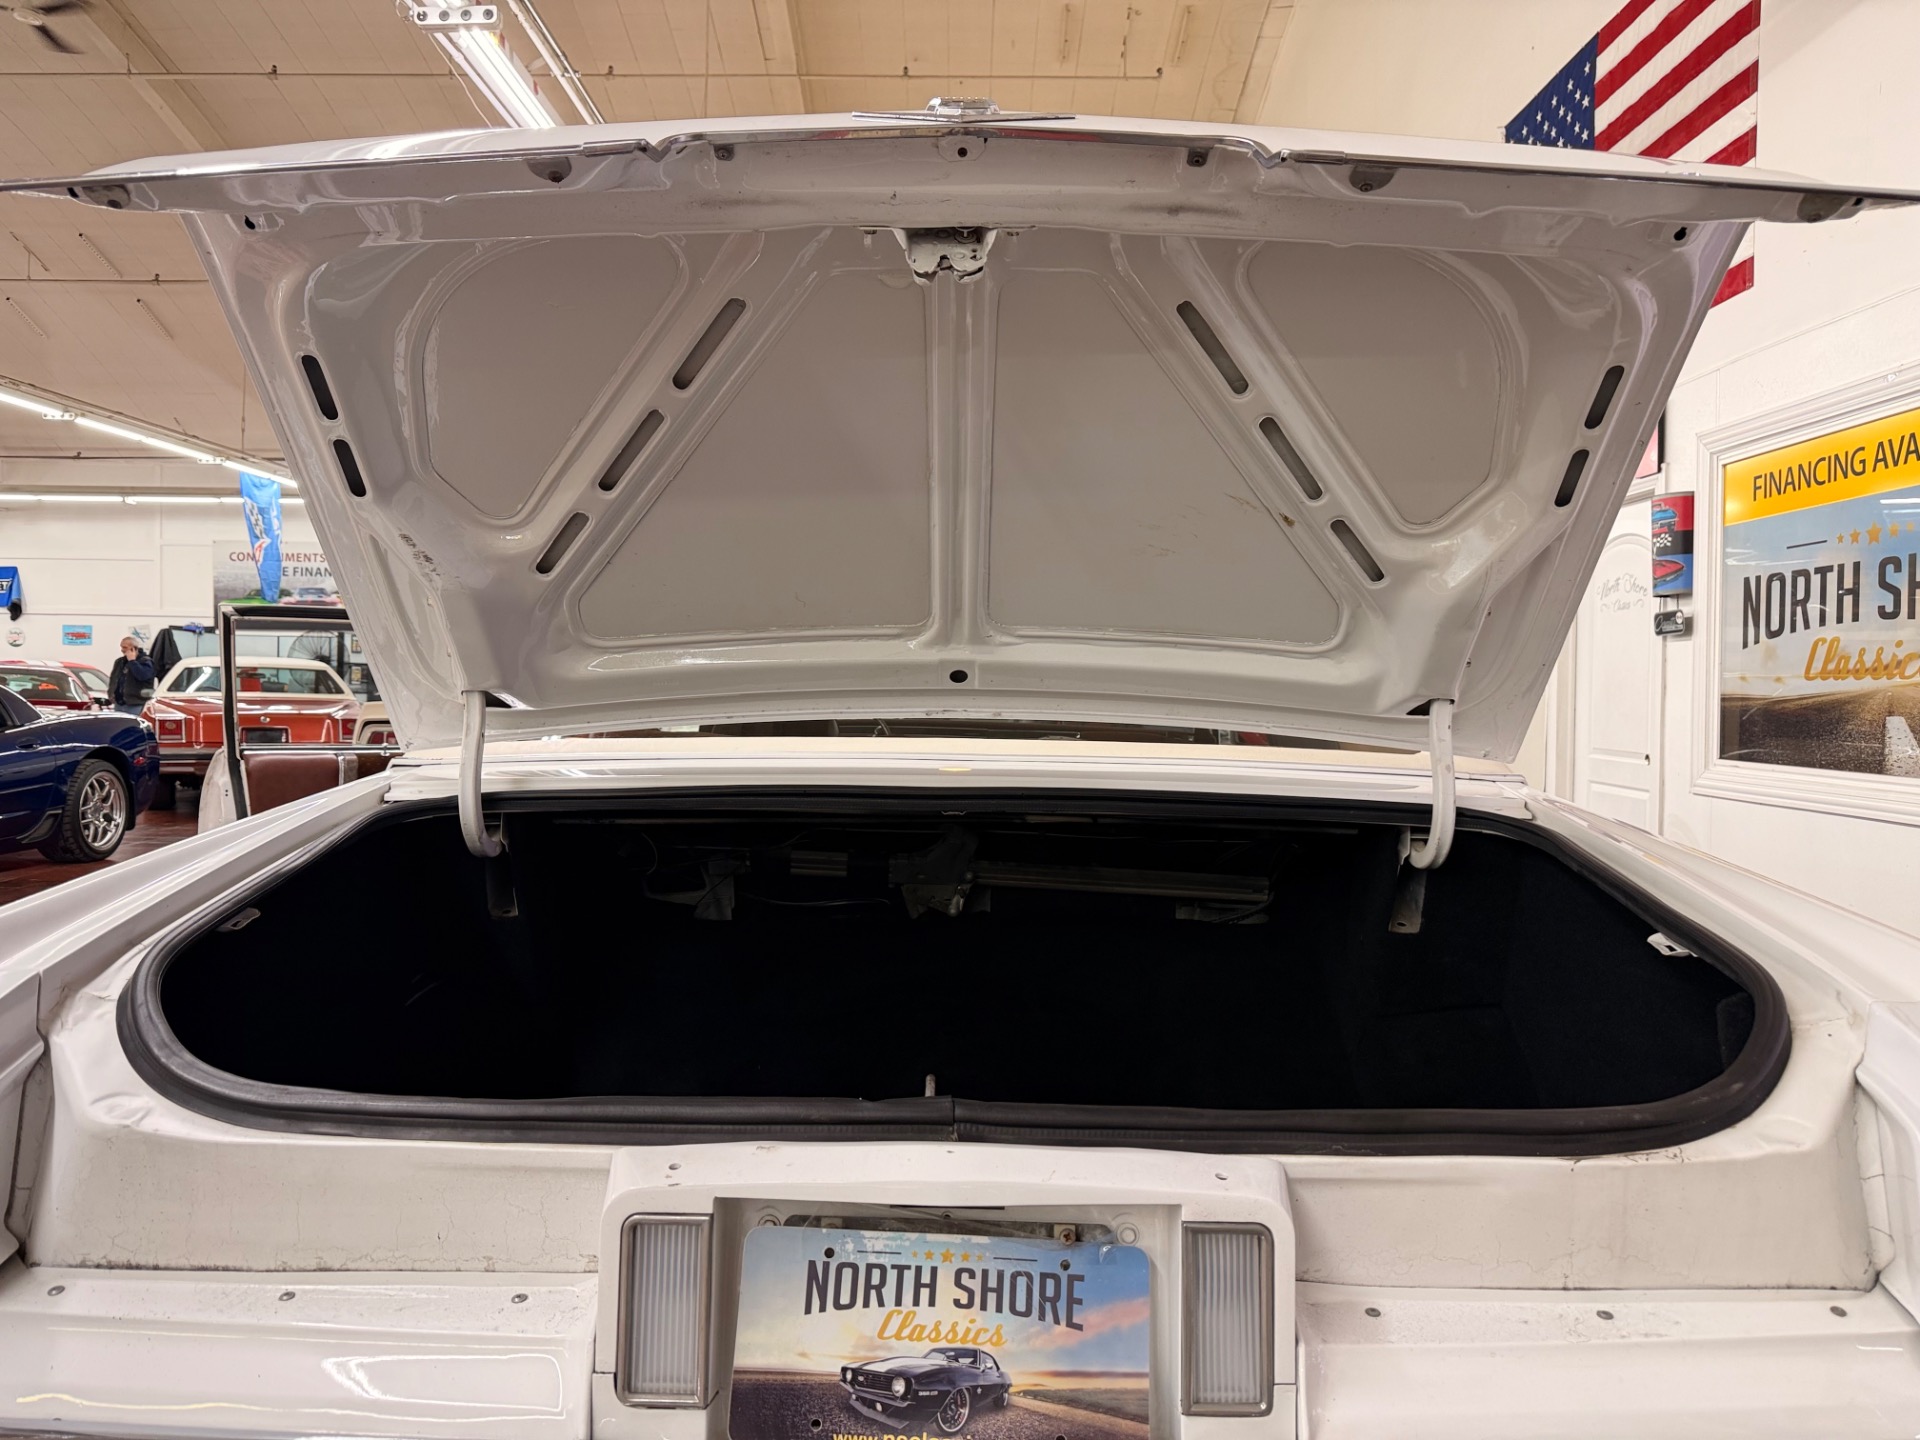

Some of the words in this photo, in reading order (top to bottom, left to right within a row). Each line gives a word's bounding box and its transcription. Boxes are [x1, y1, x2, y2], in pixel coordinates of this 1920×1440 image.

[1753, 446, 1867, 502] FINANCING
[1872, 432, 1920, 473] AVA
[229, 551, 326, 563] CONMENTS
[1742, 560, 1861, 650] NORTH
[804, 1260, 938, 1315] NORTH
[952, 1267, 1085, 1332] SHORE
[877, 1309, 1008, 1347] Classics
